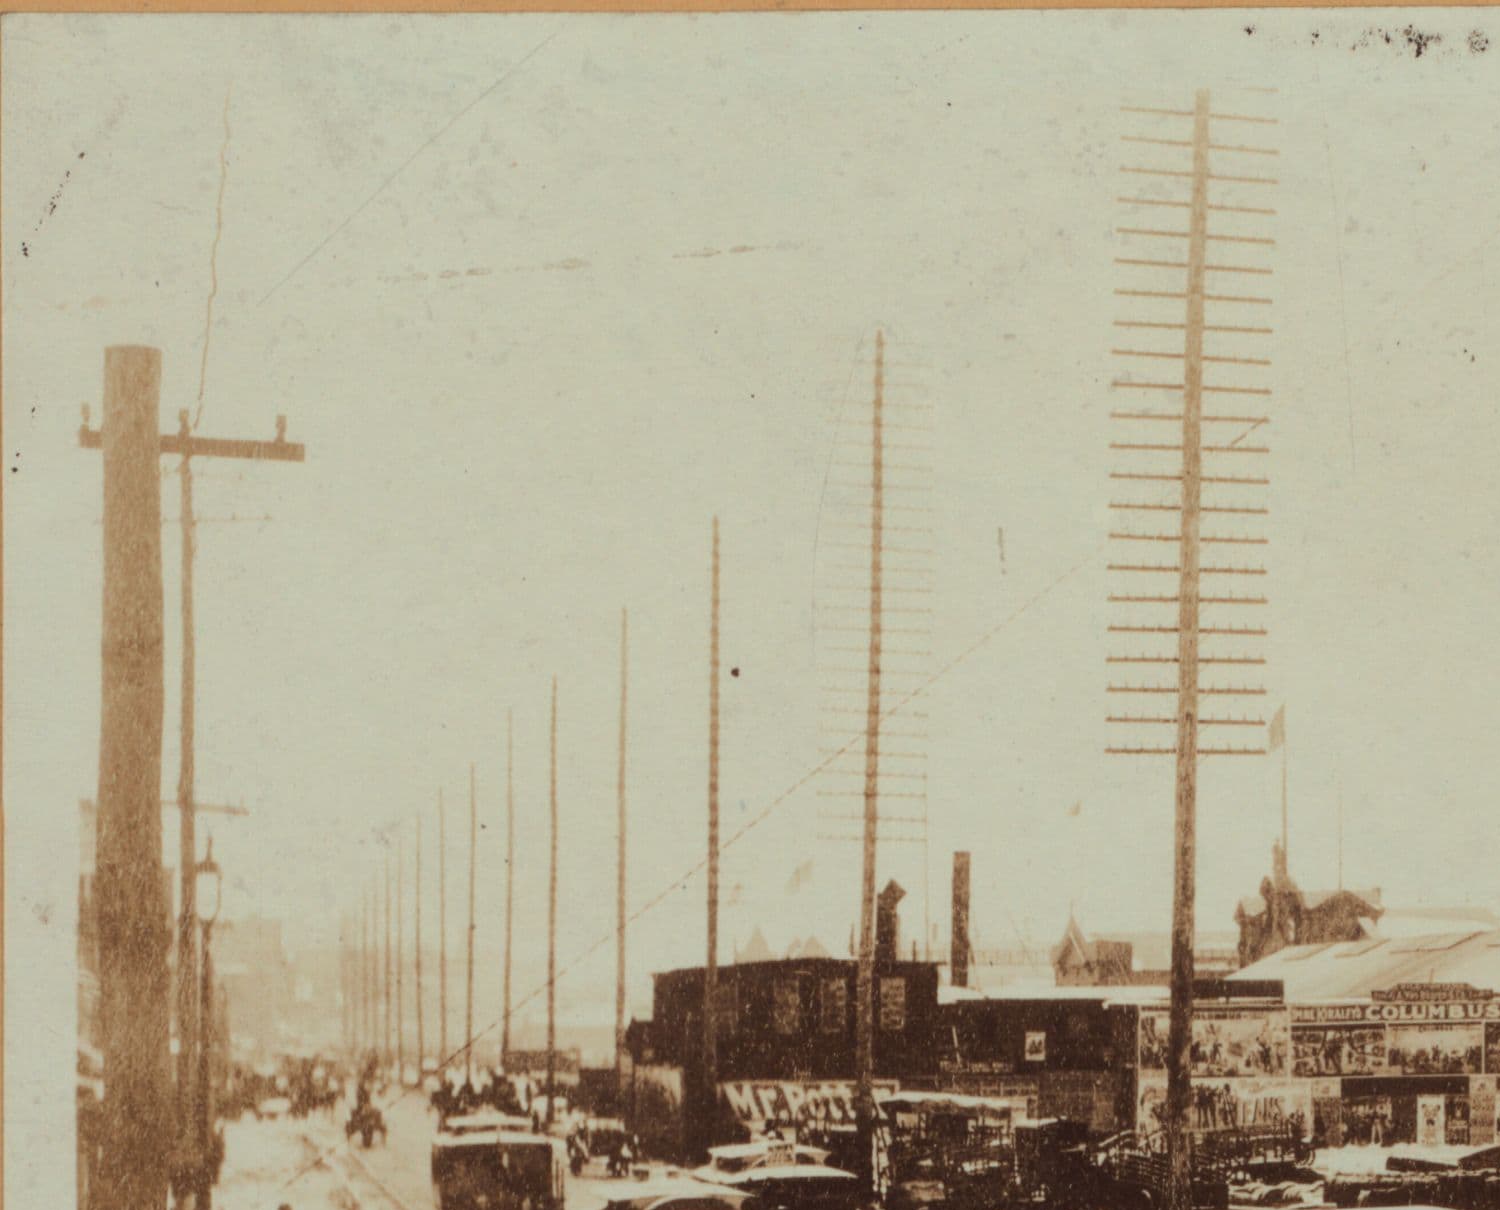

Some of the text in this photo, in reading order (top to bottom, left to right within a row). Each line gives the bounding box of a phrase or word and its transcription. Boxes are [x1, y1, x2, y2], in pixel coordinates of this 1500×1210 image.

[1366, 1003, 1500, 1019] COLUMBUS
[724, 1082, 890, 1120] Mr. Pottr
